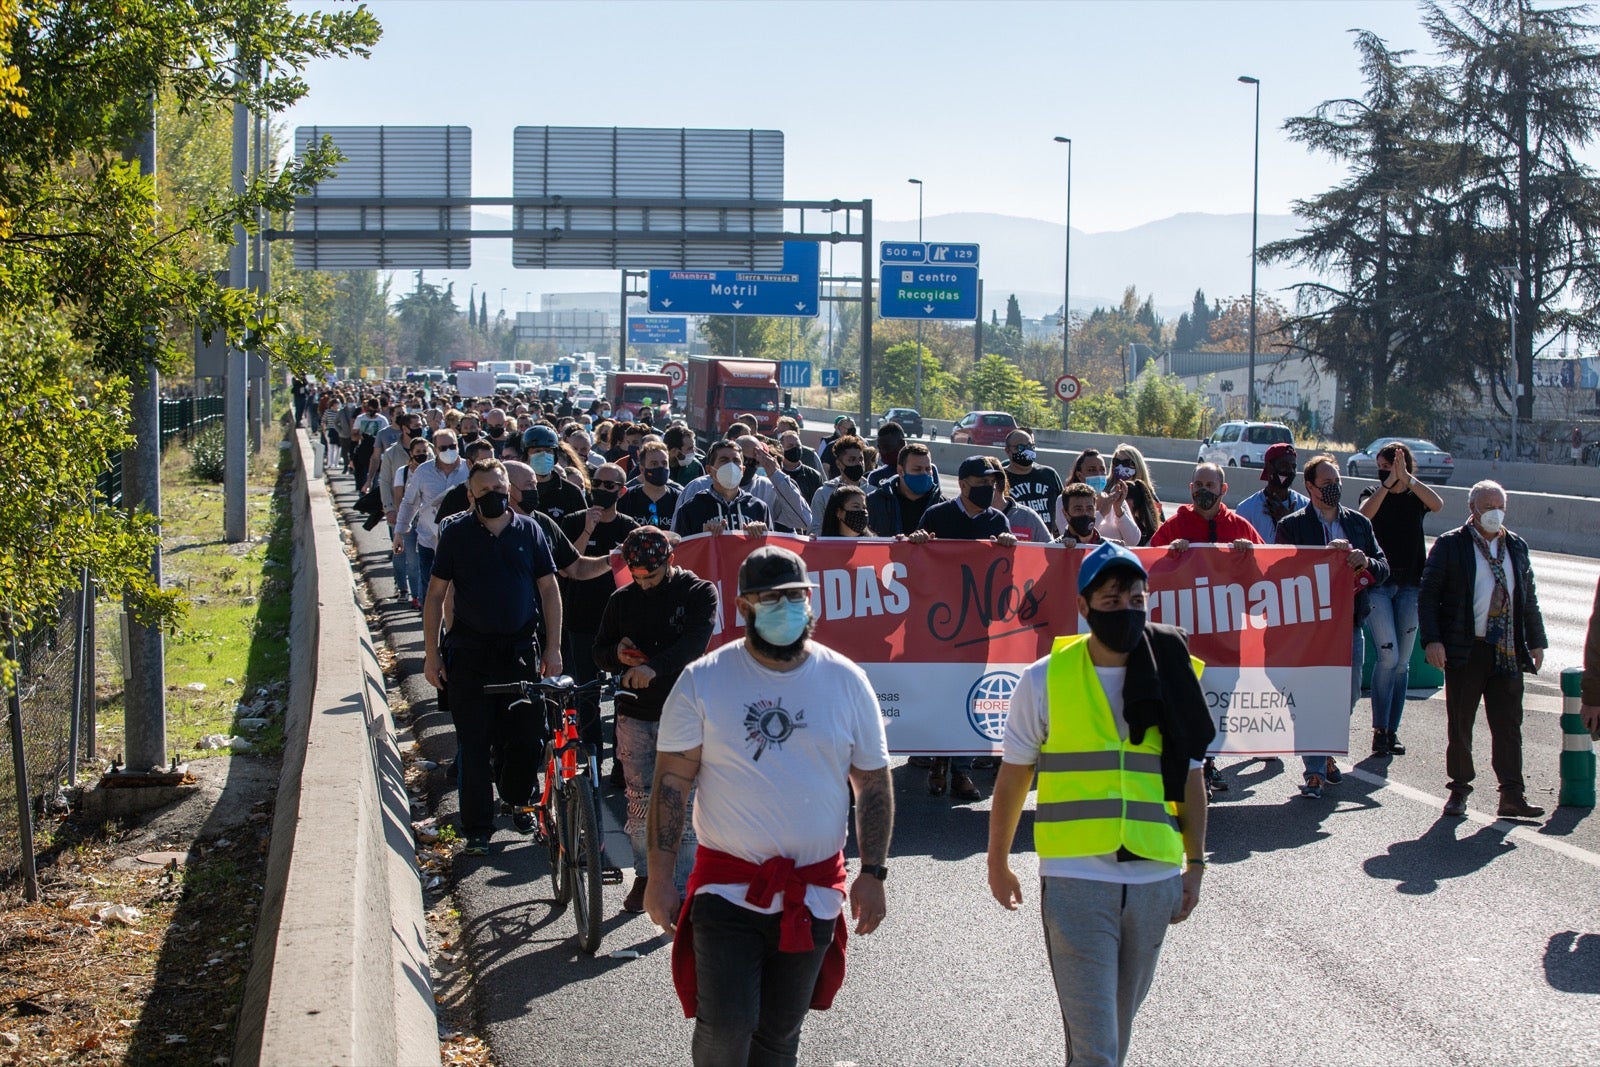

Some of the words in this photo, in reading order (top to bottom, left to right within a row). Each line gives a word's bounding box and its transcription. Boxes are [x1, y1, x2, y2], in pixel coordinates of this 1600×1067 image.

[886, 248, 908, 256] 500
[954, 250, 973, 258] 129
[763, 274, 791, 282] Nevada
[918, 273, 957, 282] centro
[711, 284, 757, 296] Motril
[898, 289, 960, 302] Recogidas
[1061, 383, 1076, 393] 90
[1009, 482, 1031, 498] CITY
[1035, 482, 1049, 495] OF
[927, 557, 1047, 641] Nos
[1078, 563, 1332, 635] ruinan!
[876, 692, 900, 702] esas
[1205, 687, 1297, 709] OSTELERÍA
[881, 706, 900, 717] ada
[974, 702, 1009, 711] HORE
[1219, 711, 1286, 733] ESPAÑA
